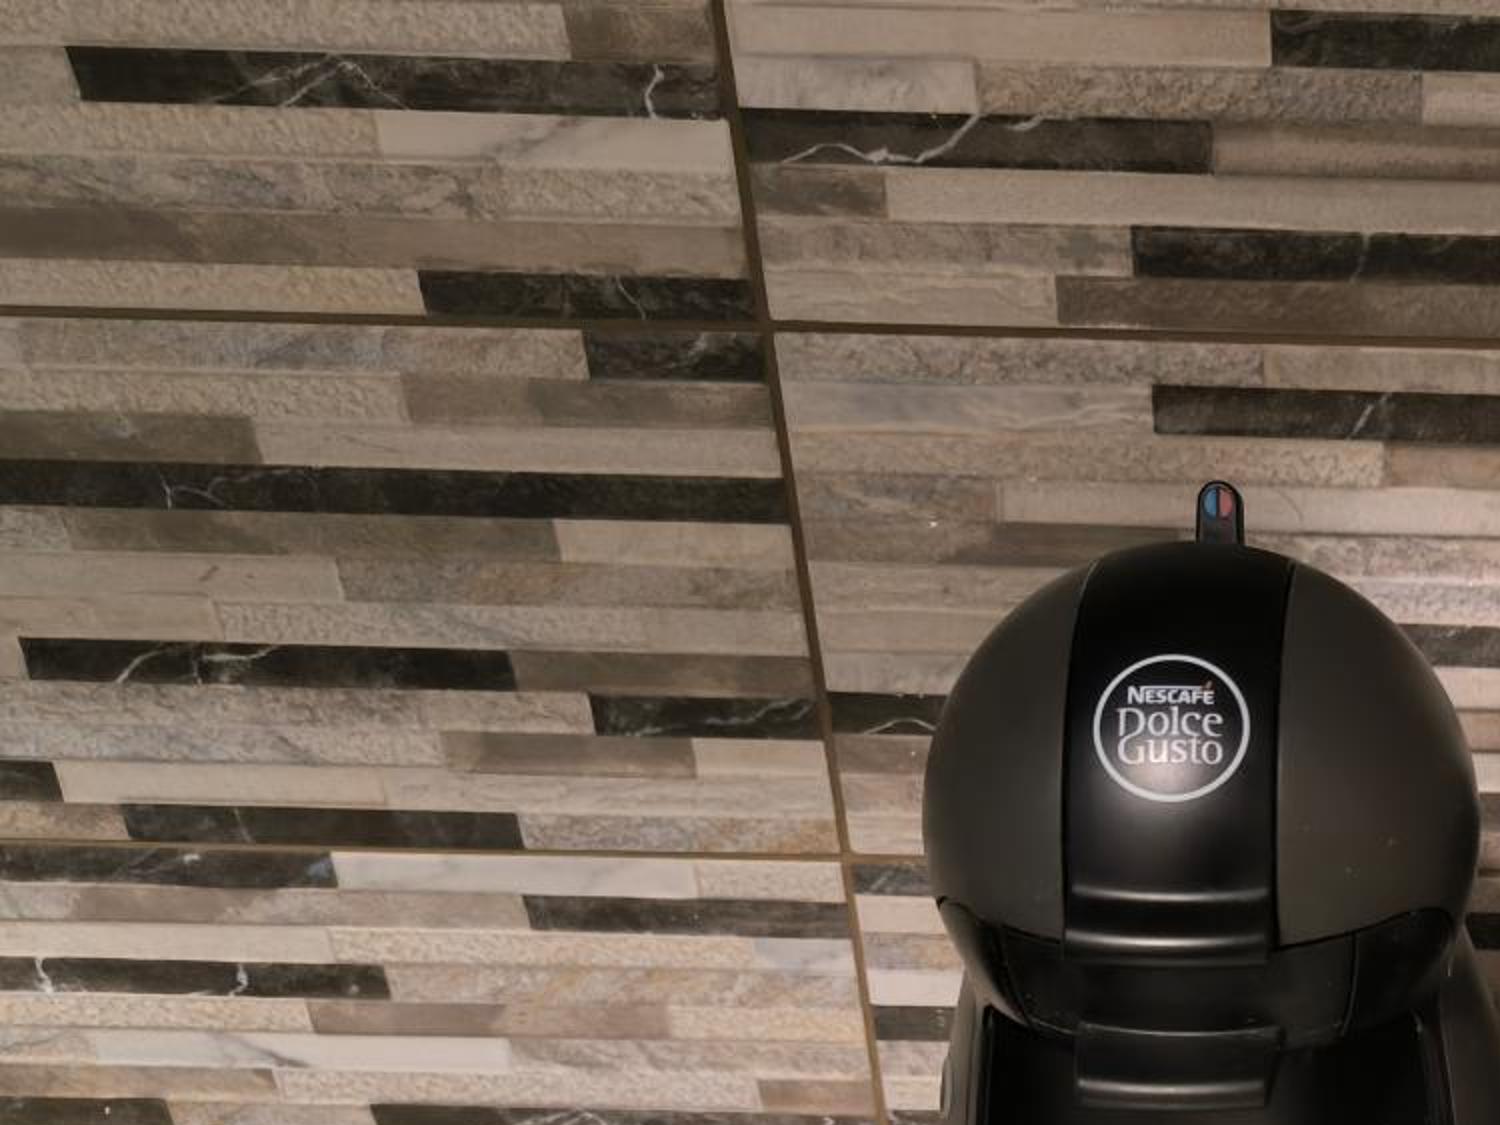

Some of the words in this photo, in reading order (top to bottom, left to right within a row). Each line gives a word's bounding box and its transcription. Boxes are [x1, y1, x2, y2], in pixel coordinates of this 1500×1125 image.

[1127, 681, 1215, 705] NESCAFÉ
[1117, 706, 1224, 737] Dolce
[1117, 736, 1224, 765] Gusto
